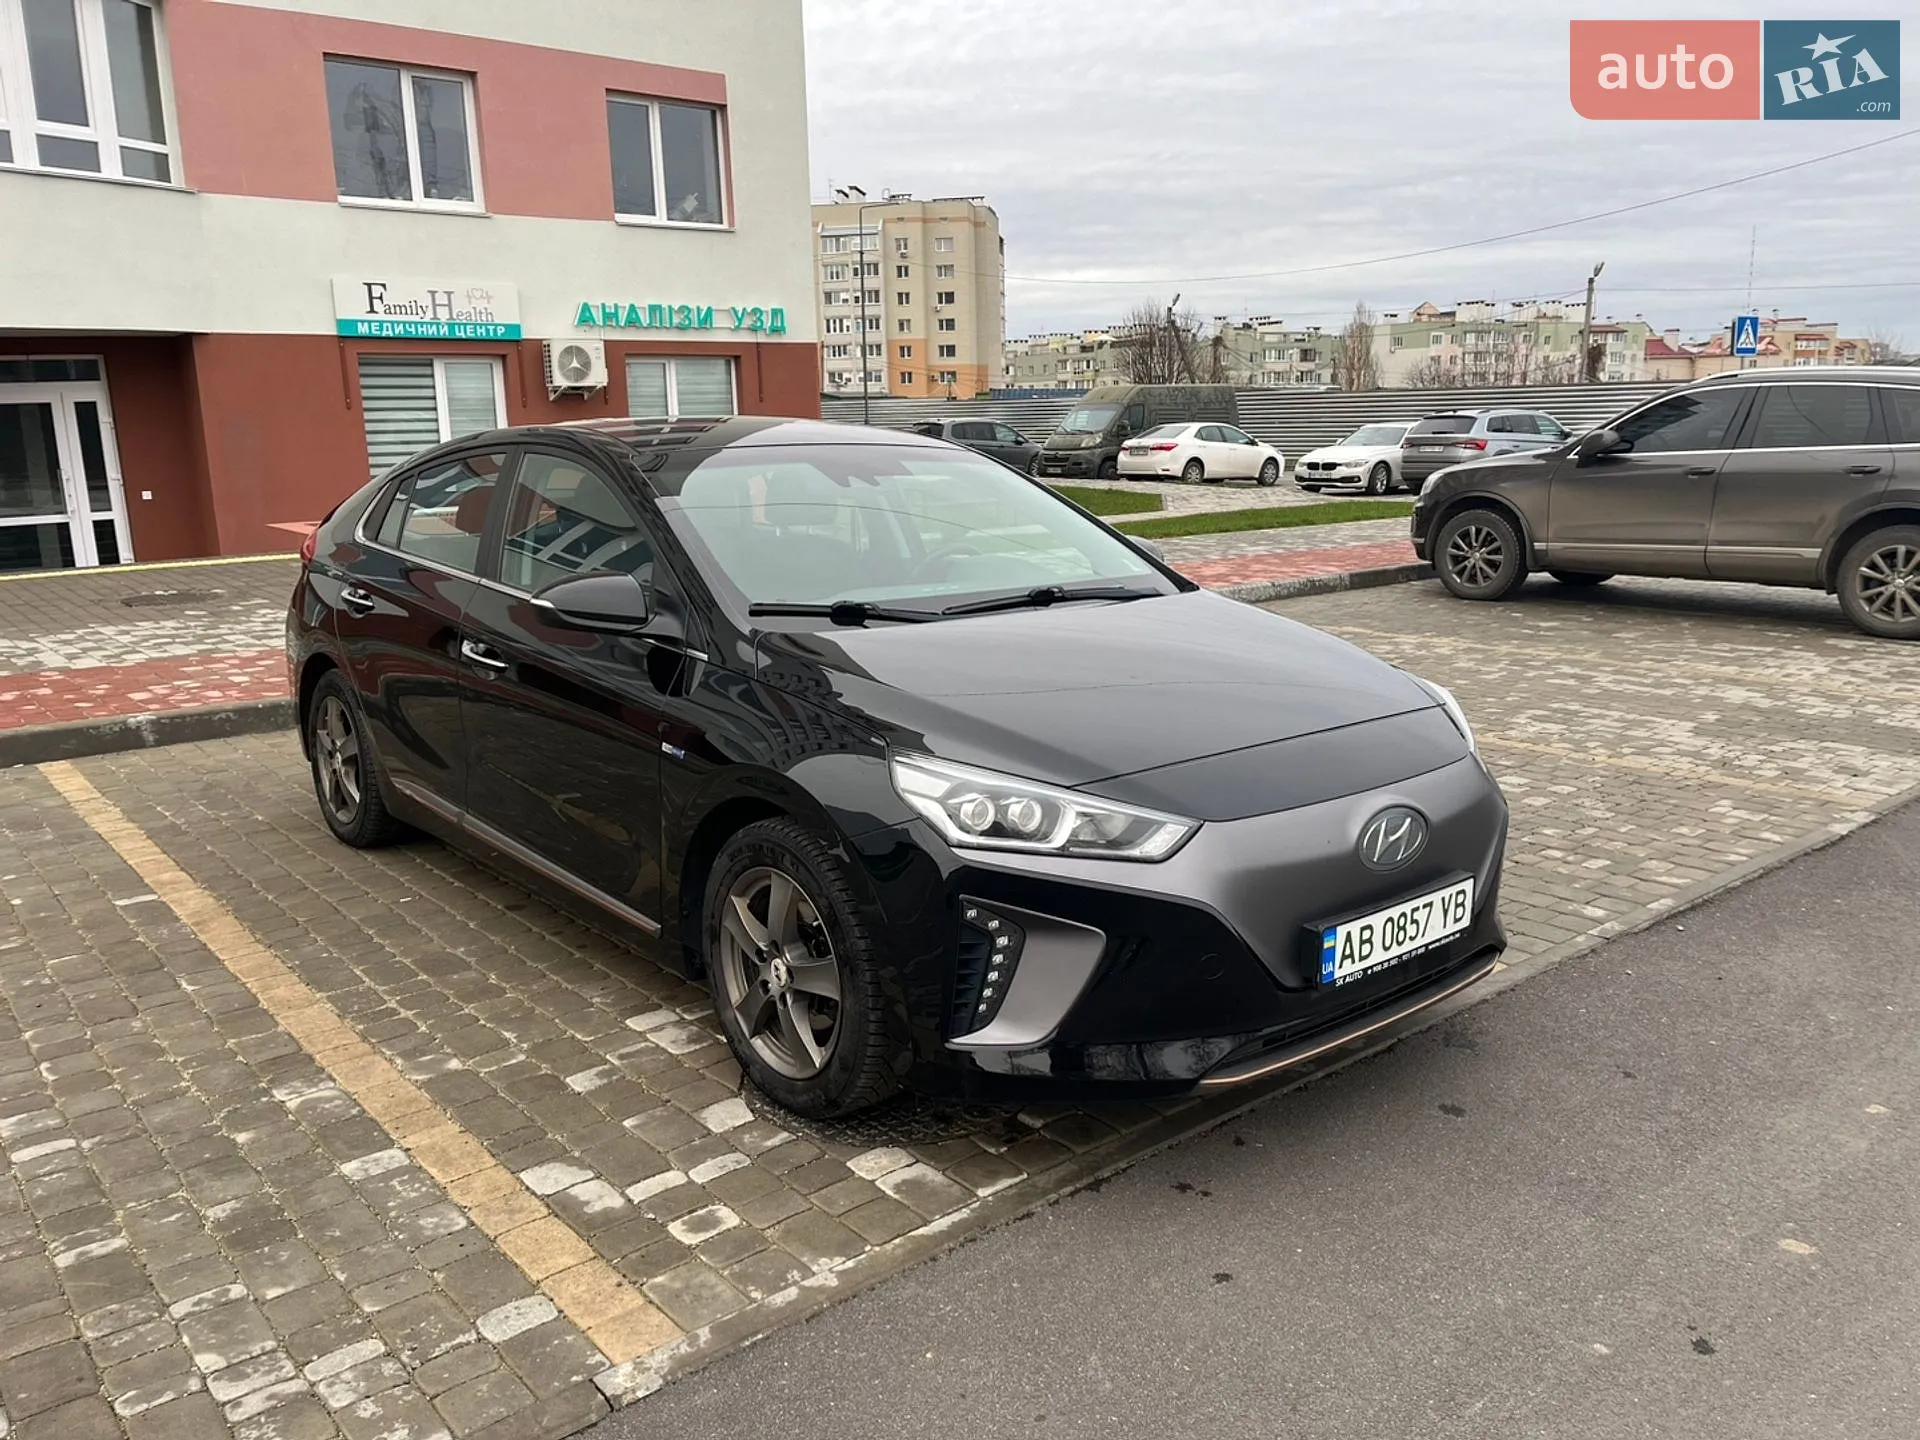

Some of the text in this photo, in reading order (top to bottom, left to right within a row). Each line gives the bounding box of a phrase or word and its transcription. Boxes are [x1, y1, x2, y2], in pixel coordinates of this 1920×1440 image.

[575, 302, 787, 335] АНАЛІЗИ УЗД
[357, 320, 506, 338] МЕДИЧНИЙ ЦЕНТР
[1338, 924, 1374, 969] AB
[1382, 901, 1434, 952] 0857
[1441, 889, 1467, 929] YB
[1322, 961, 1334, 975] UA
[1345, 970, 1363, 984] AUTO
